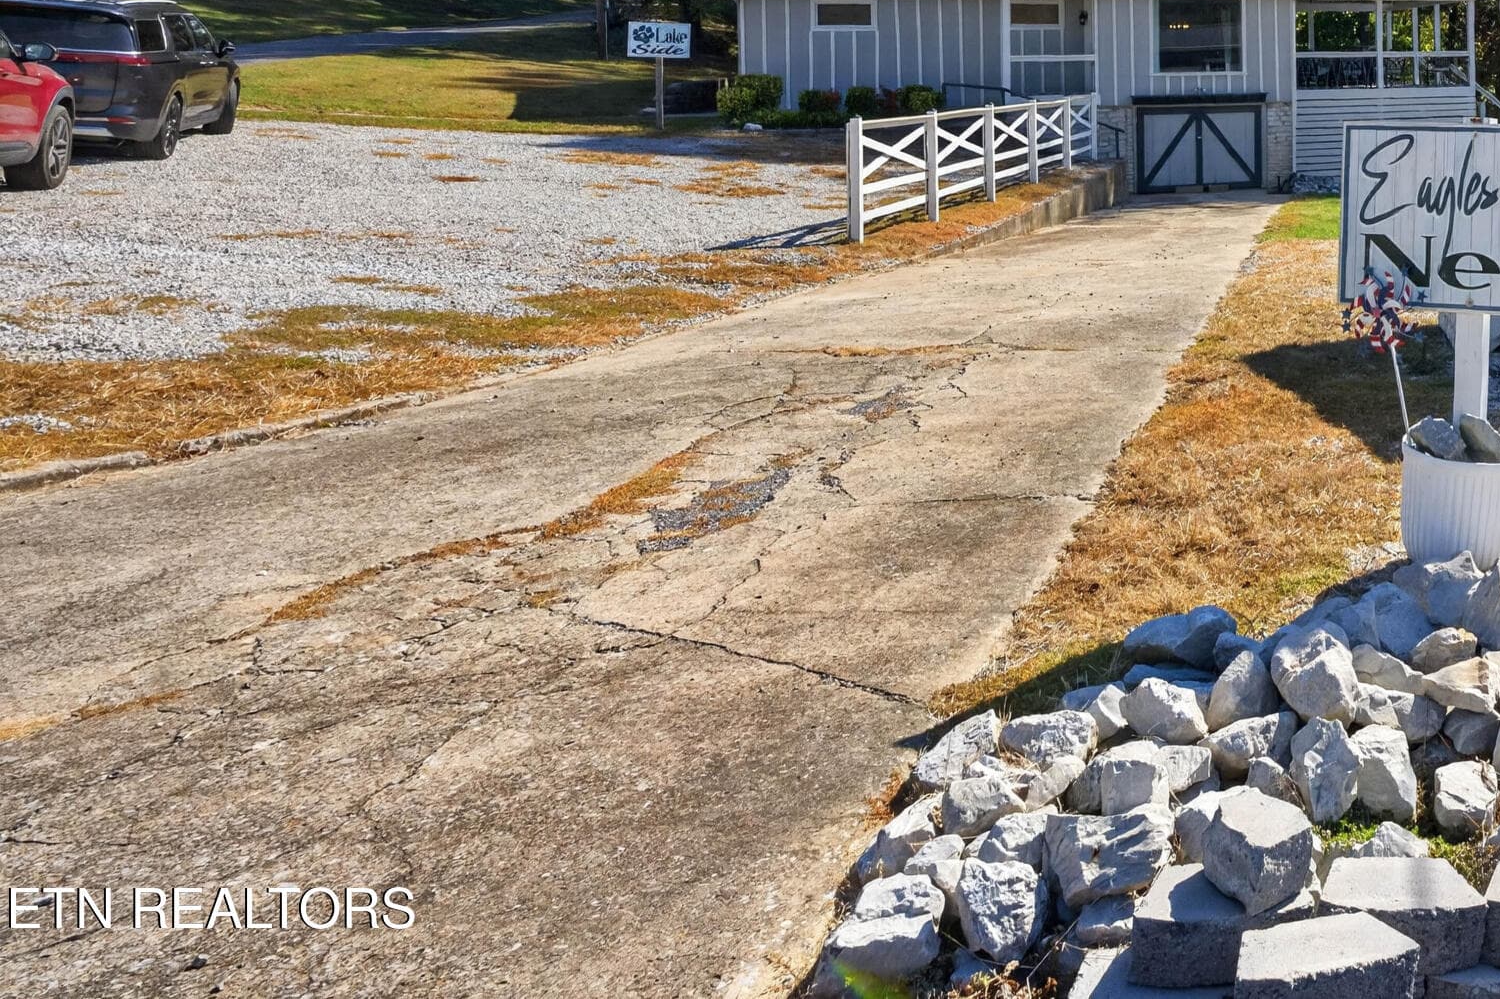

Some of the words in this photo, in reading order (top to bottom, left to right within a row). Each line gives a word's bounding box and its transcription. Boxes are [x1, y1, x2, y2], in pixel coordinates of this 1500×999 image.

[656, 27, 688, 44] Lake
[632, 44, 687, 56] Side
[1359, 133, 1499, 258] Eagles
